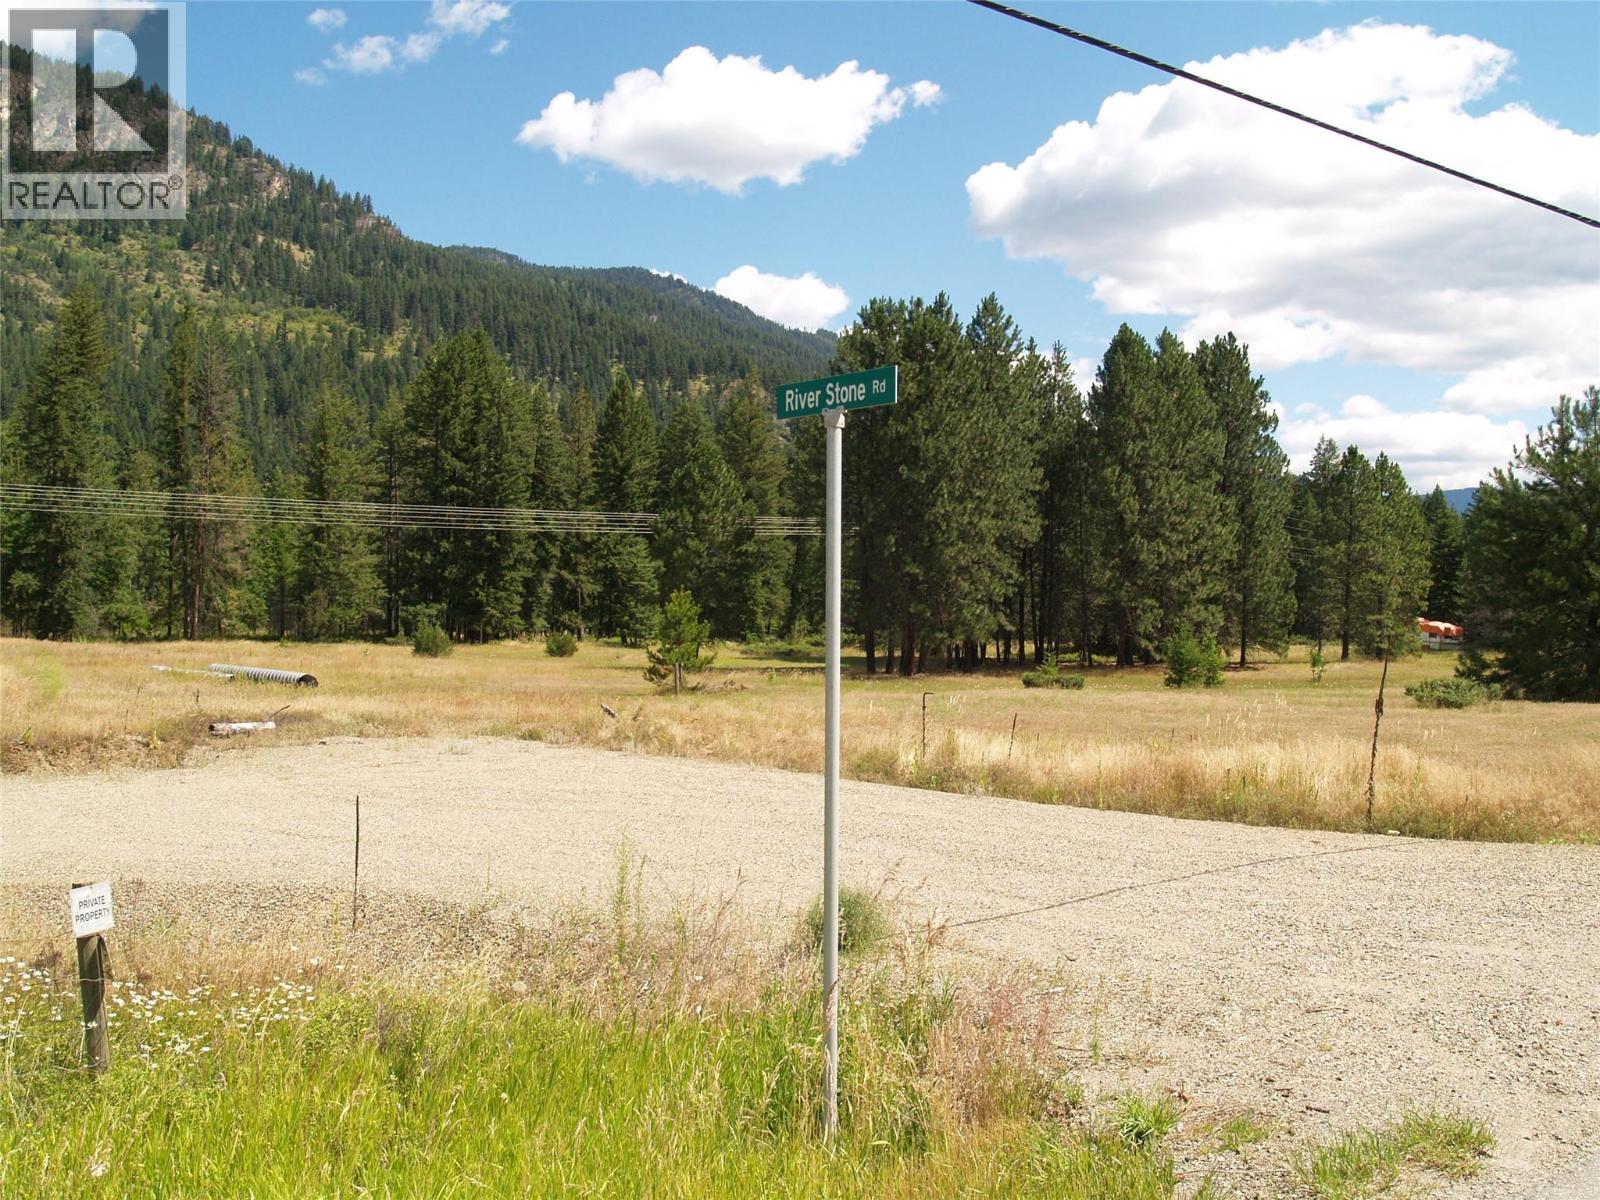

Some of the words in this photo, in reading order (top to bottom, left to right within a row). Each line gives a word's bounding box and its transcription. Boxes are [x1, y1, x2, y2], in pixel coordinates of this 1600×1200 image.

[785, 388, 821, 412] River
[826, 382, 866, 405] Stone
[872, 379, 886, 394] Rd
[78, 895, 106, 910] PRIVATE
[75, 907, 110, 924] PROPERTY
